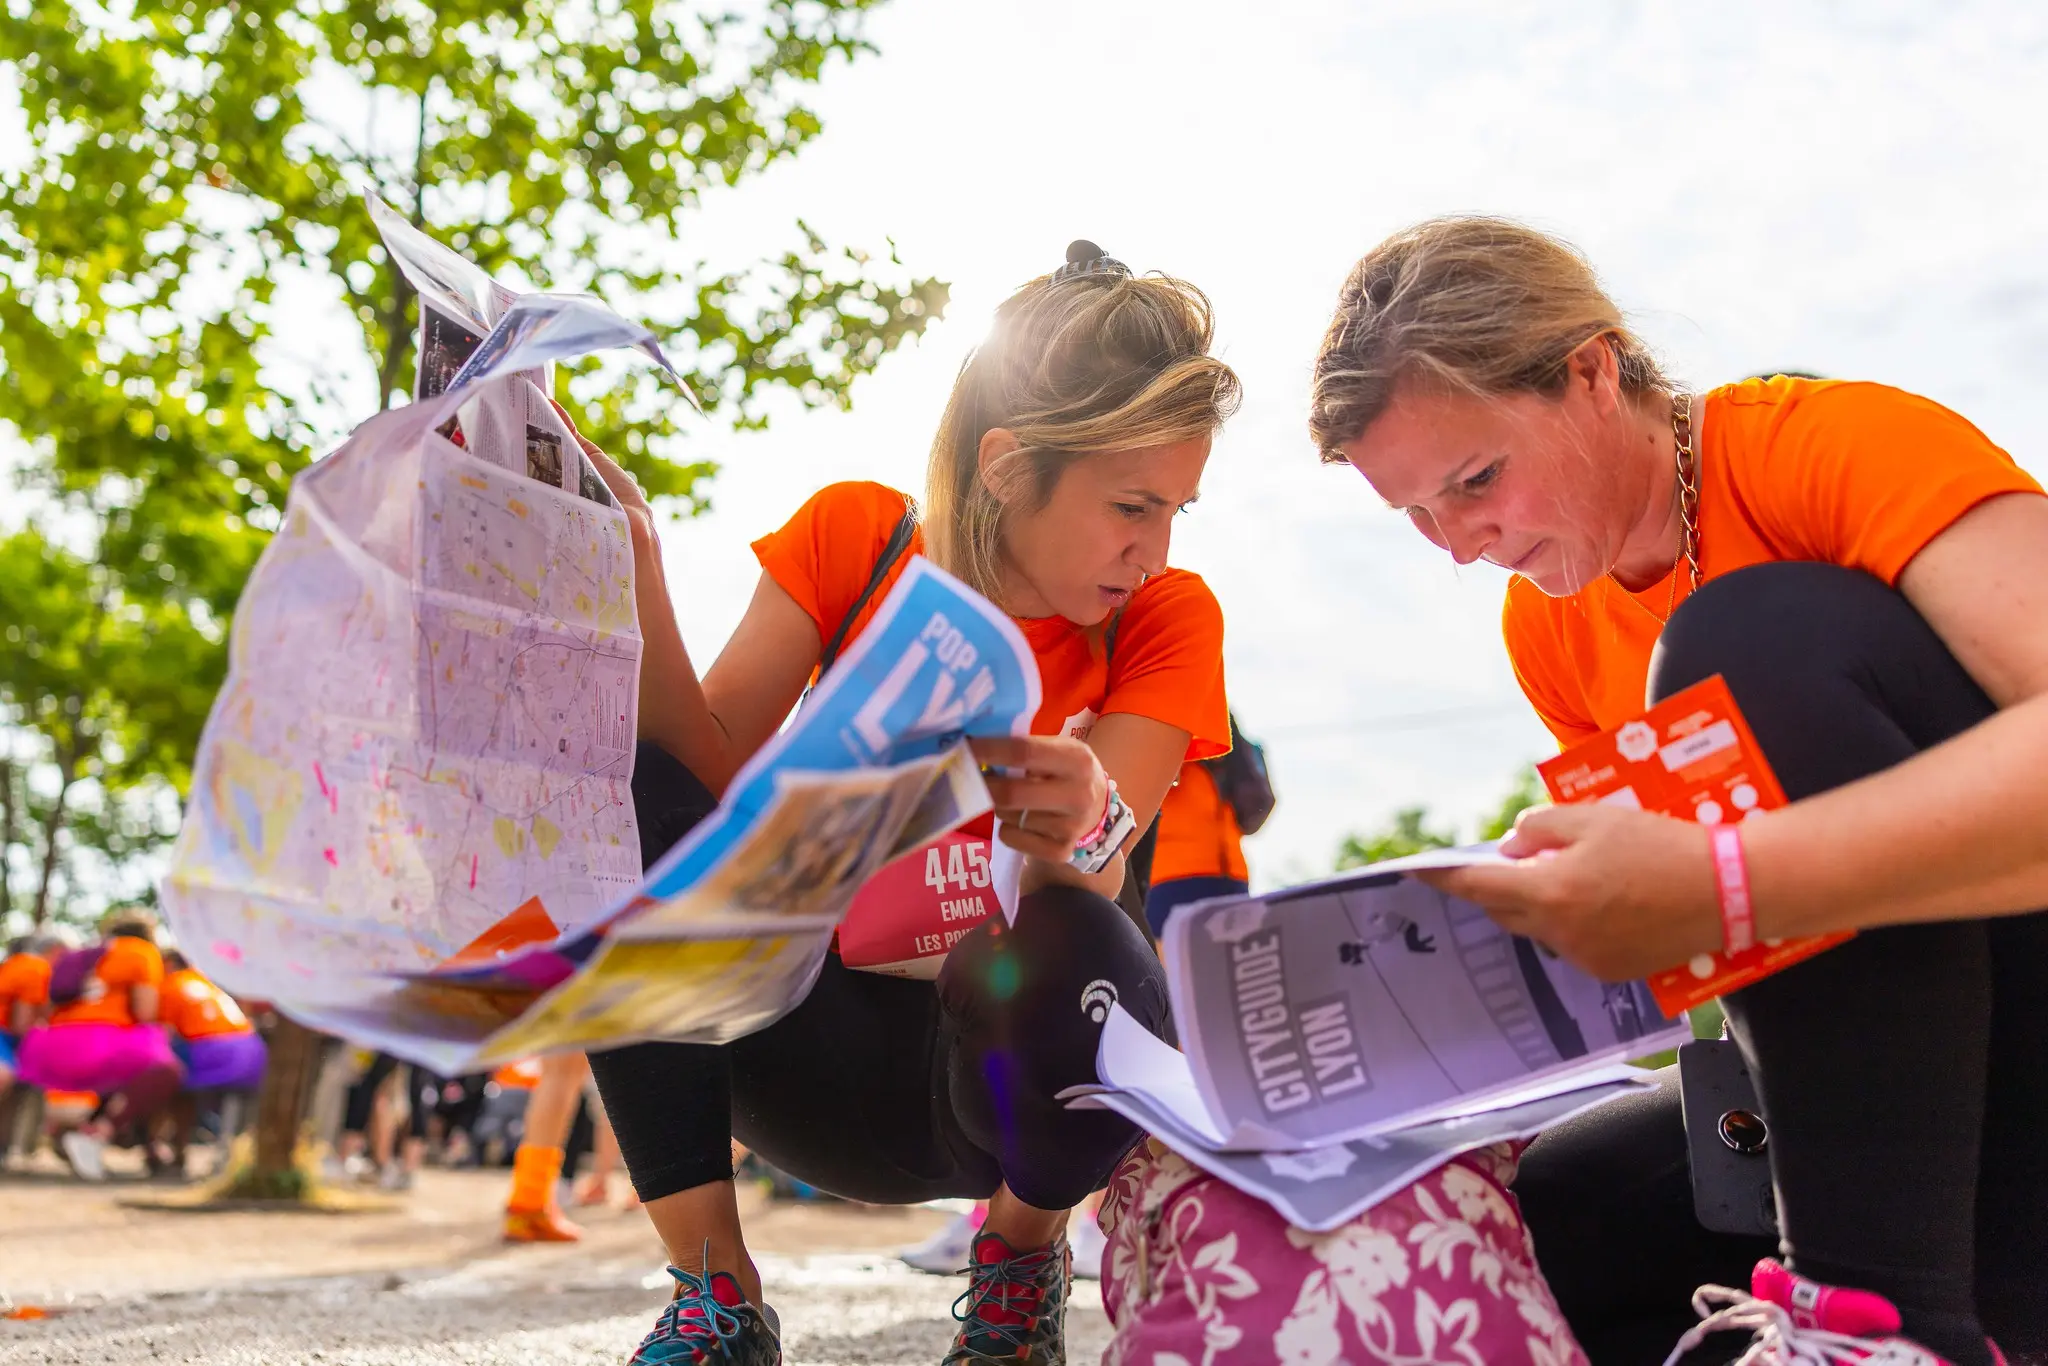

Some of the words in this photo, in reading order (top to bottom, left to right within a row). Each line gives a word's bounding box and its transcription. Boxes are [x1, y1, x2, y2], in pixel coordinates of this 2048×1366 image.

[919, 611, 979, 673] POP
[925, 841, 991, 894] 445
[940, 896, 986, 922] EMMA
[915, 933, 942, 954] LES
[1232, 933, 1312, 1113] CITYGUIDE
[1300, 1001, 1367, 1098] LYON
